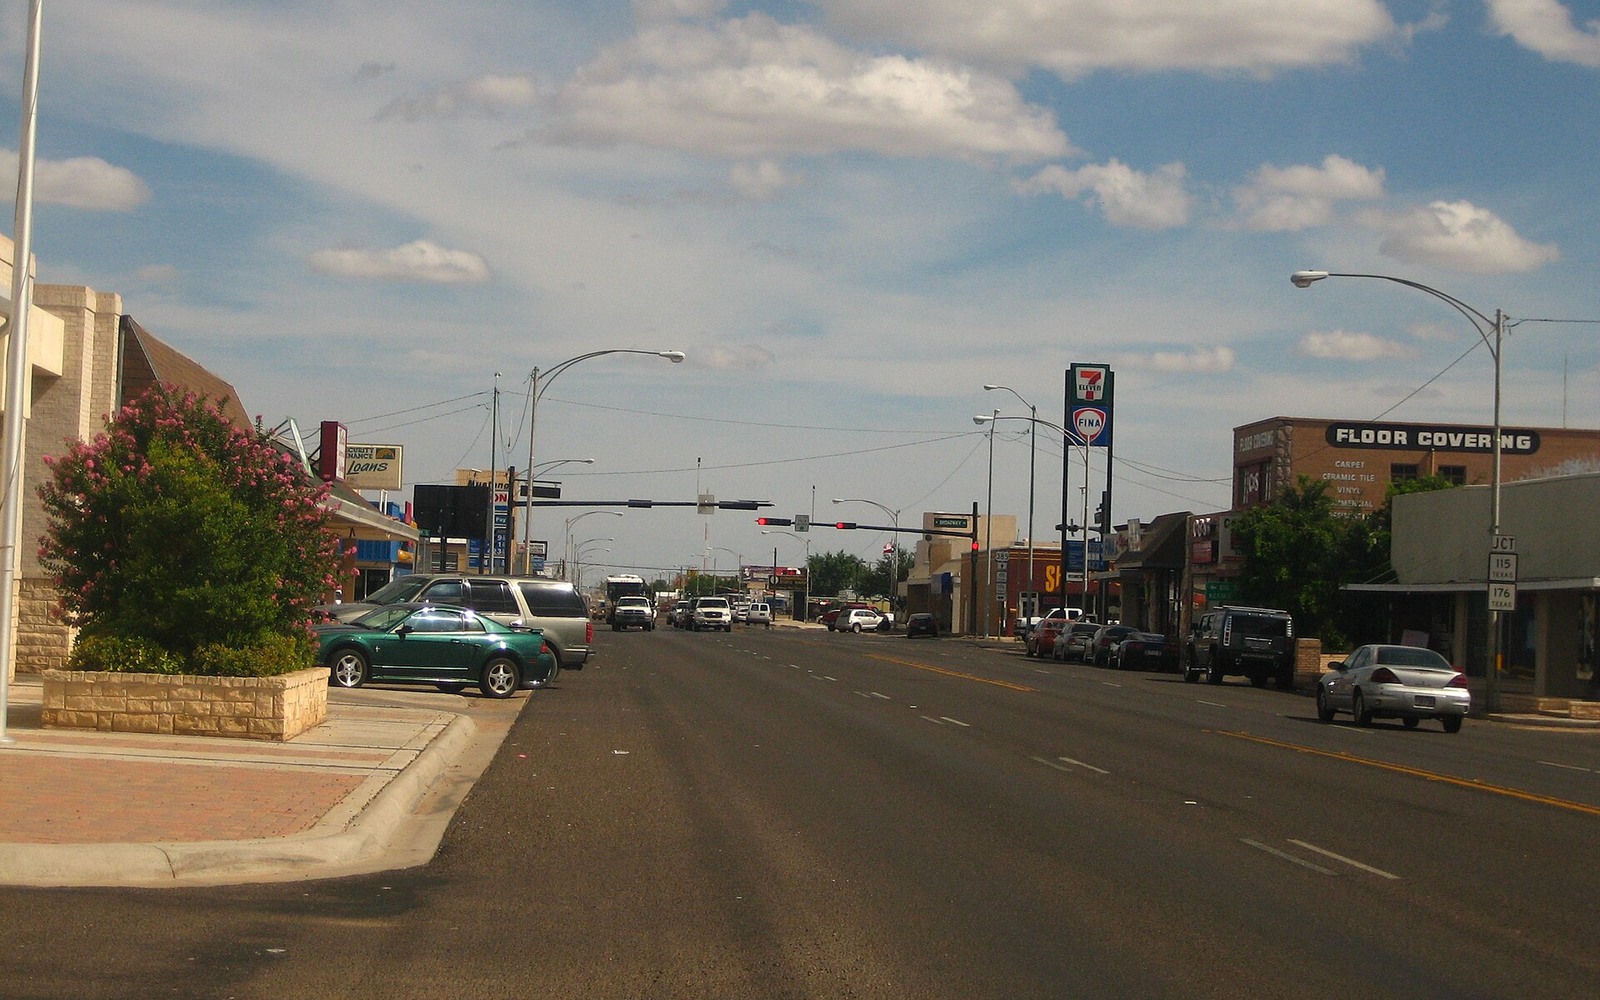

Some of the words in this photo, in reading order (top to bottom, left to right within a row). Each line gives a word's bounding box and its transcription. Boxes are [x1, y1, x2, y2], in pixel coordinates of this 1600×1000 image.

[1078, 418, 1101, 428] FINA
[1336, 428, 1408, 445] FLOOR
[1417, 431, 1532, 450] COVERNG
[346, 460, 389, 475] Loans
[1335, 460, 1365, 469] CARPET
[1322, 472, 1356, 481] CERAMIC
[1360, 474, 1375, 482] TILE
[1337, 486, 1361, 495] VINYL
[1492, 537, 1515, 550] JCT
[1496, 558, 1511, 569] 115
[1493, 587, 1511, 598] 176
